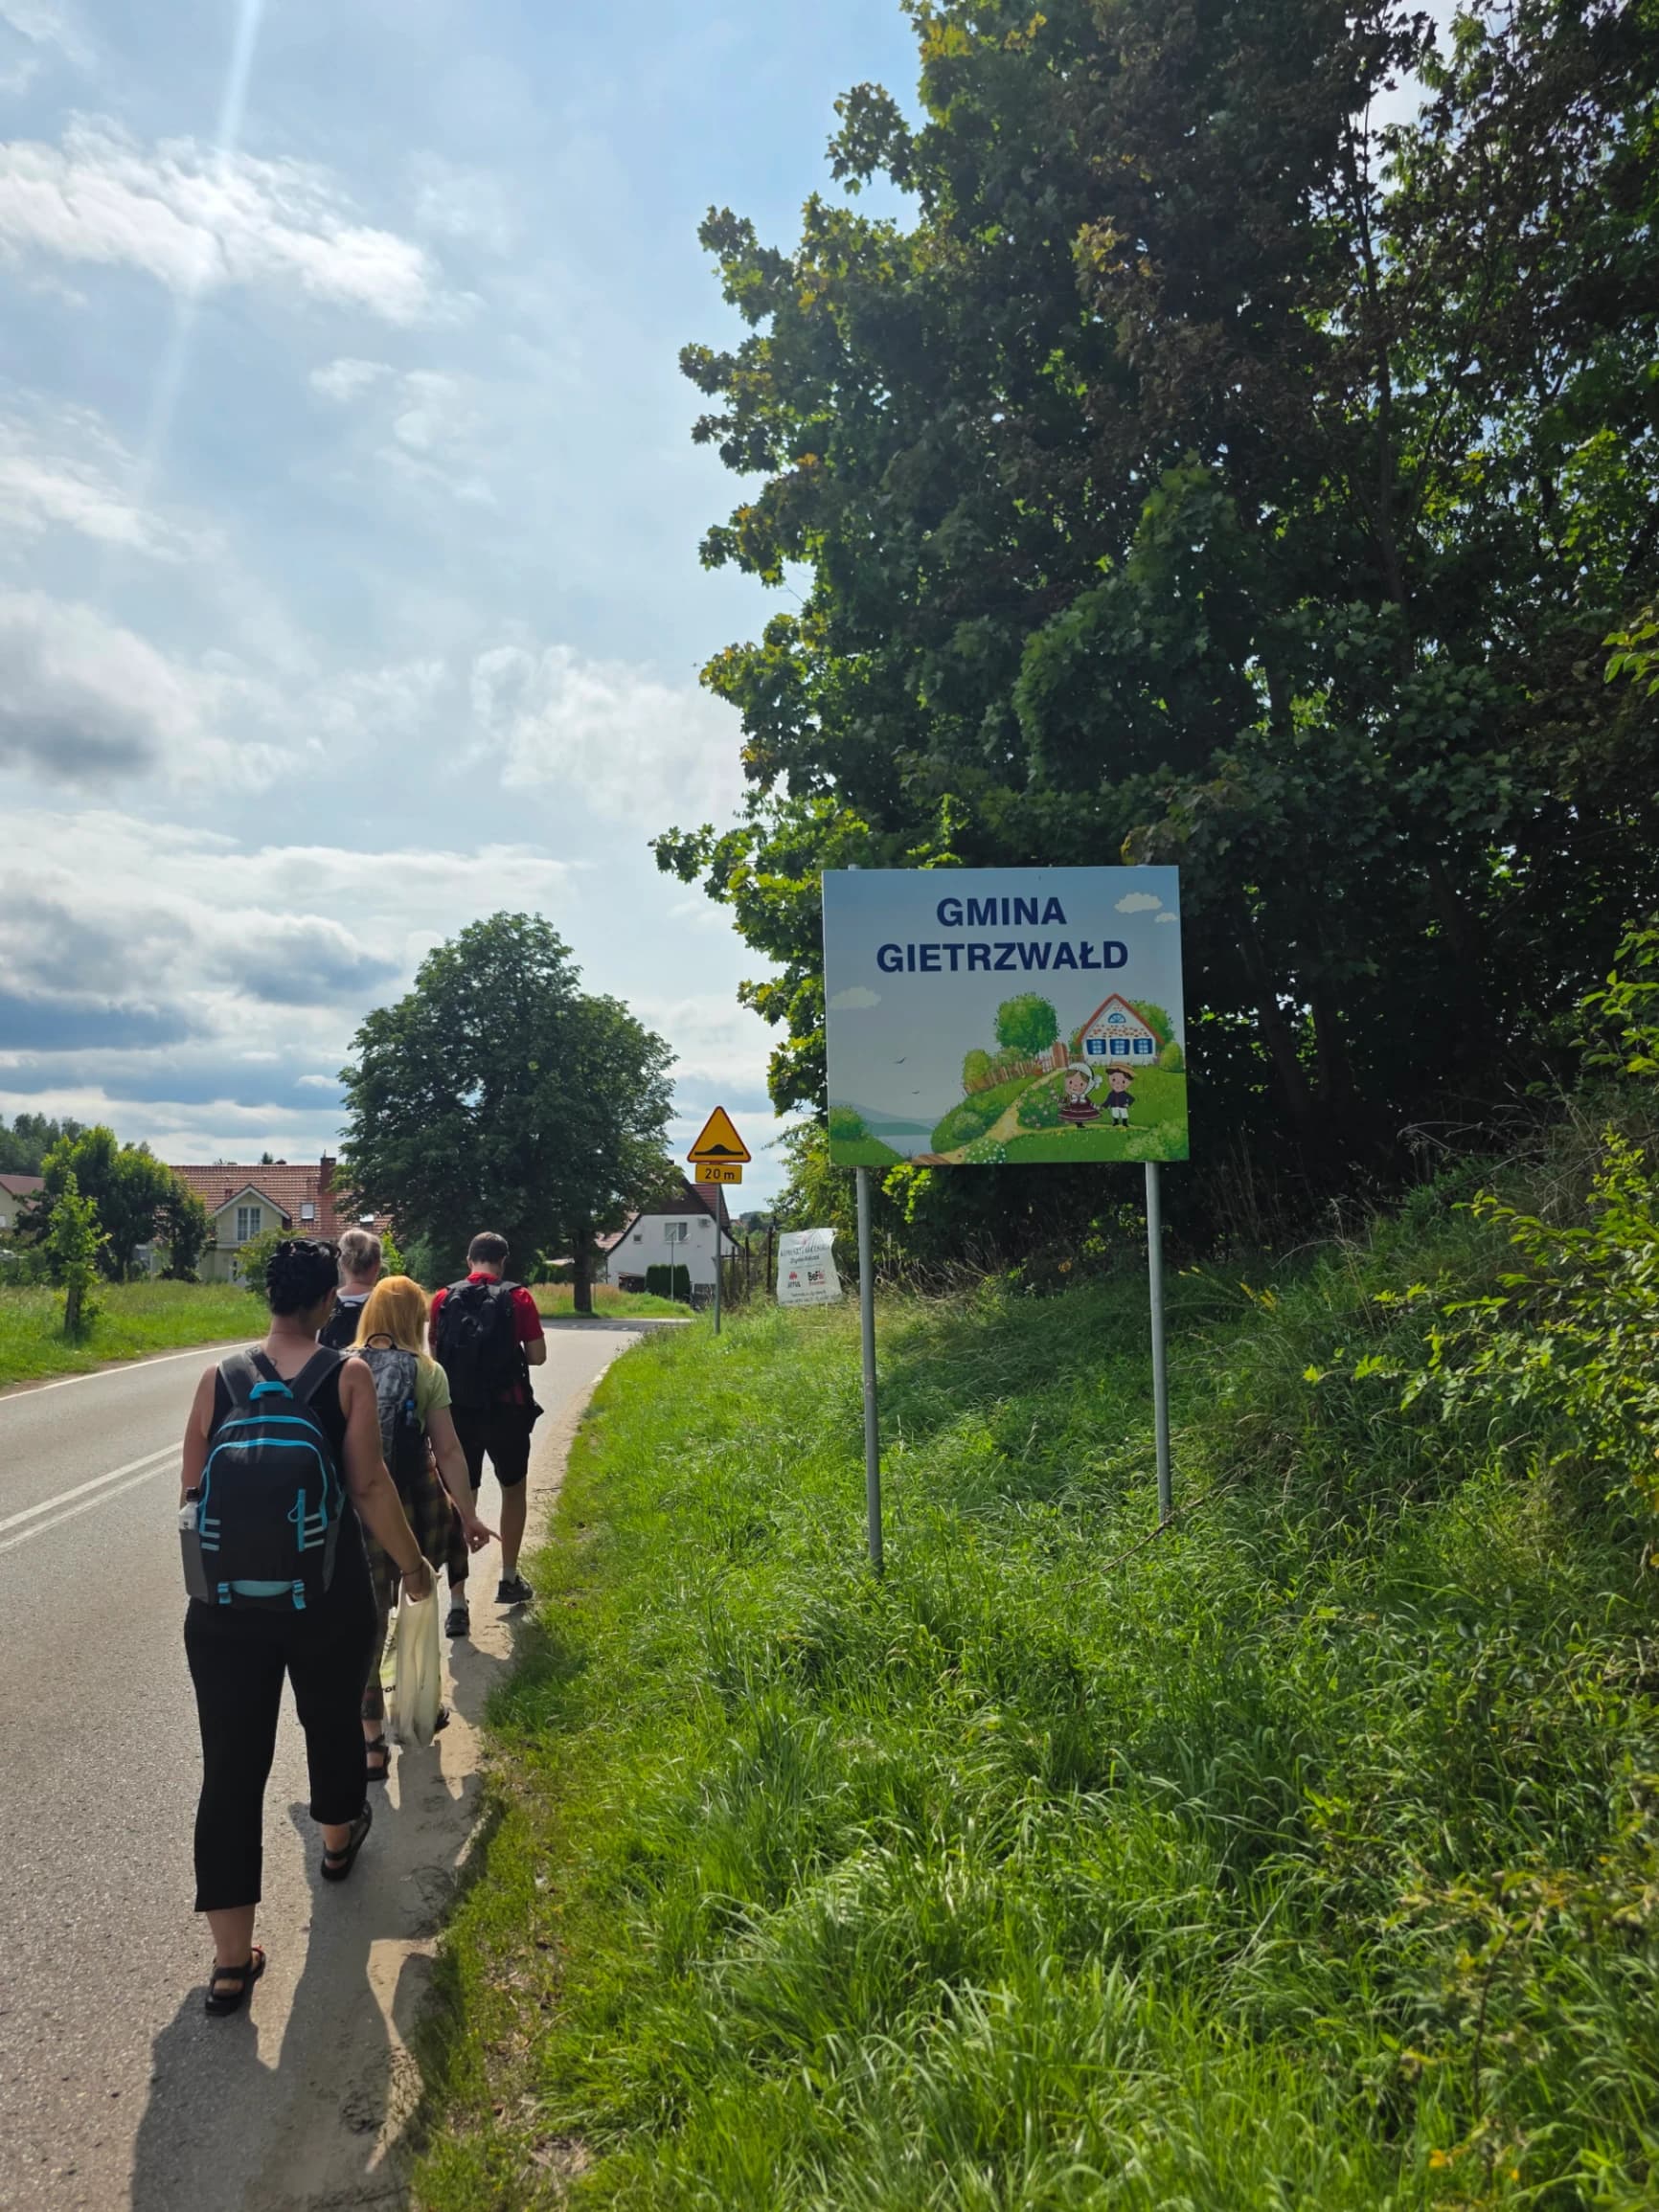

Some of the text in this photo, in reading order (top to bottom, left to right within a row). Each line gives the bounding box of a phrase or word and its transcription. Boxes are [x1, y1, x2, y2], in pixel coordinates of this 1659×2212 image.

[937, 896, 1068, 927] GMINA
[875, 940, 1129, 973] GIETRZWAŁD
[705, 1167, 735, 1181] 20 m
